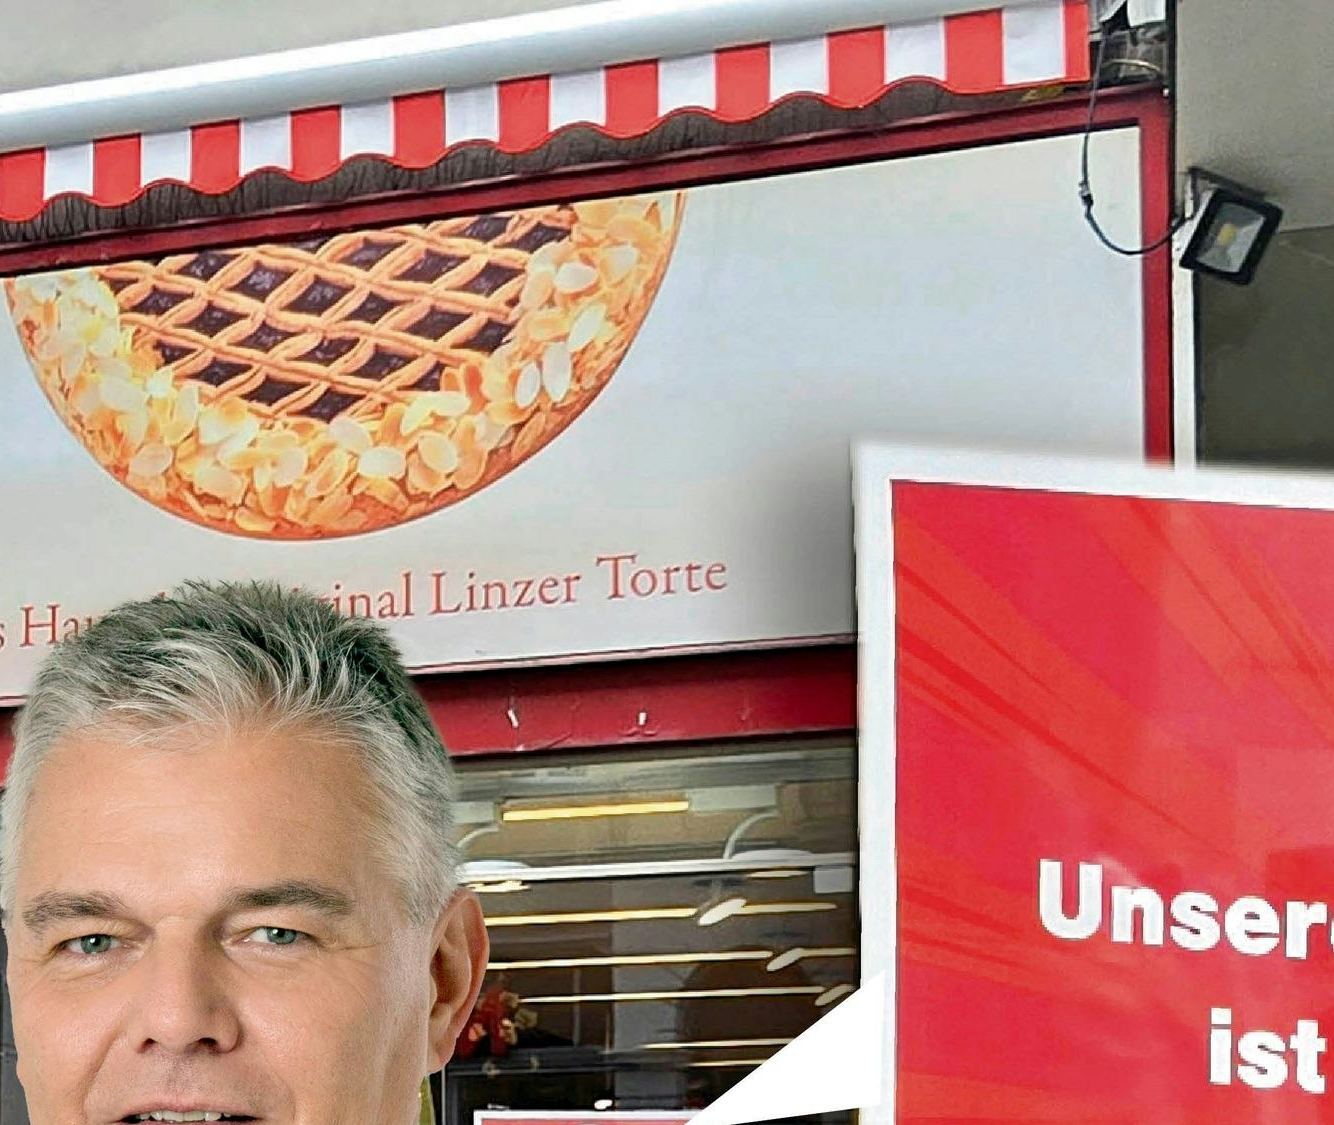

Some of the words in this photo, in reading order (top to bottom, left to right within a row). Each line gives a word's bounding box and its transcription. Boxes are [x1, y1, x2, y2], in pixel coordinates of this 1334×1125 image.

[20, 602, 105, 647] Ha
[431, 572, 582, 614] Linzer
[596, 555, 729, 600] Torte
[1209, 1007, 1327, 1093] ist
